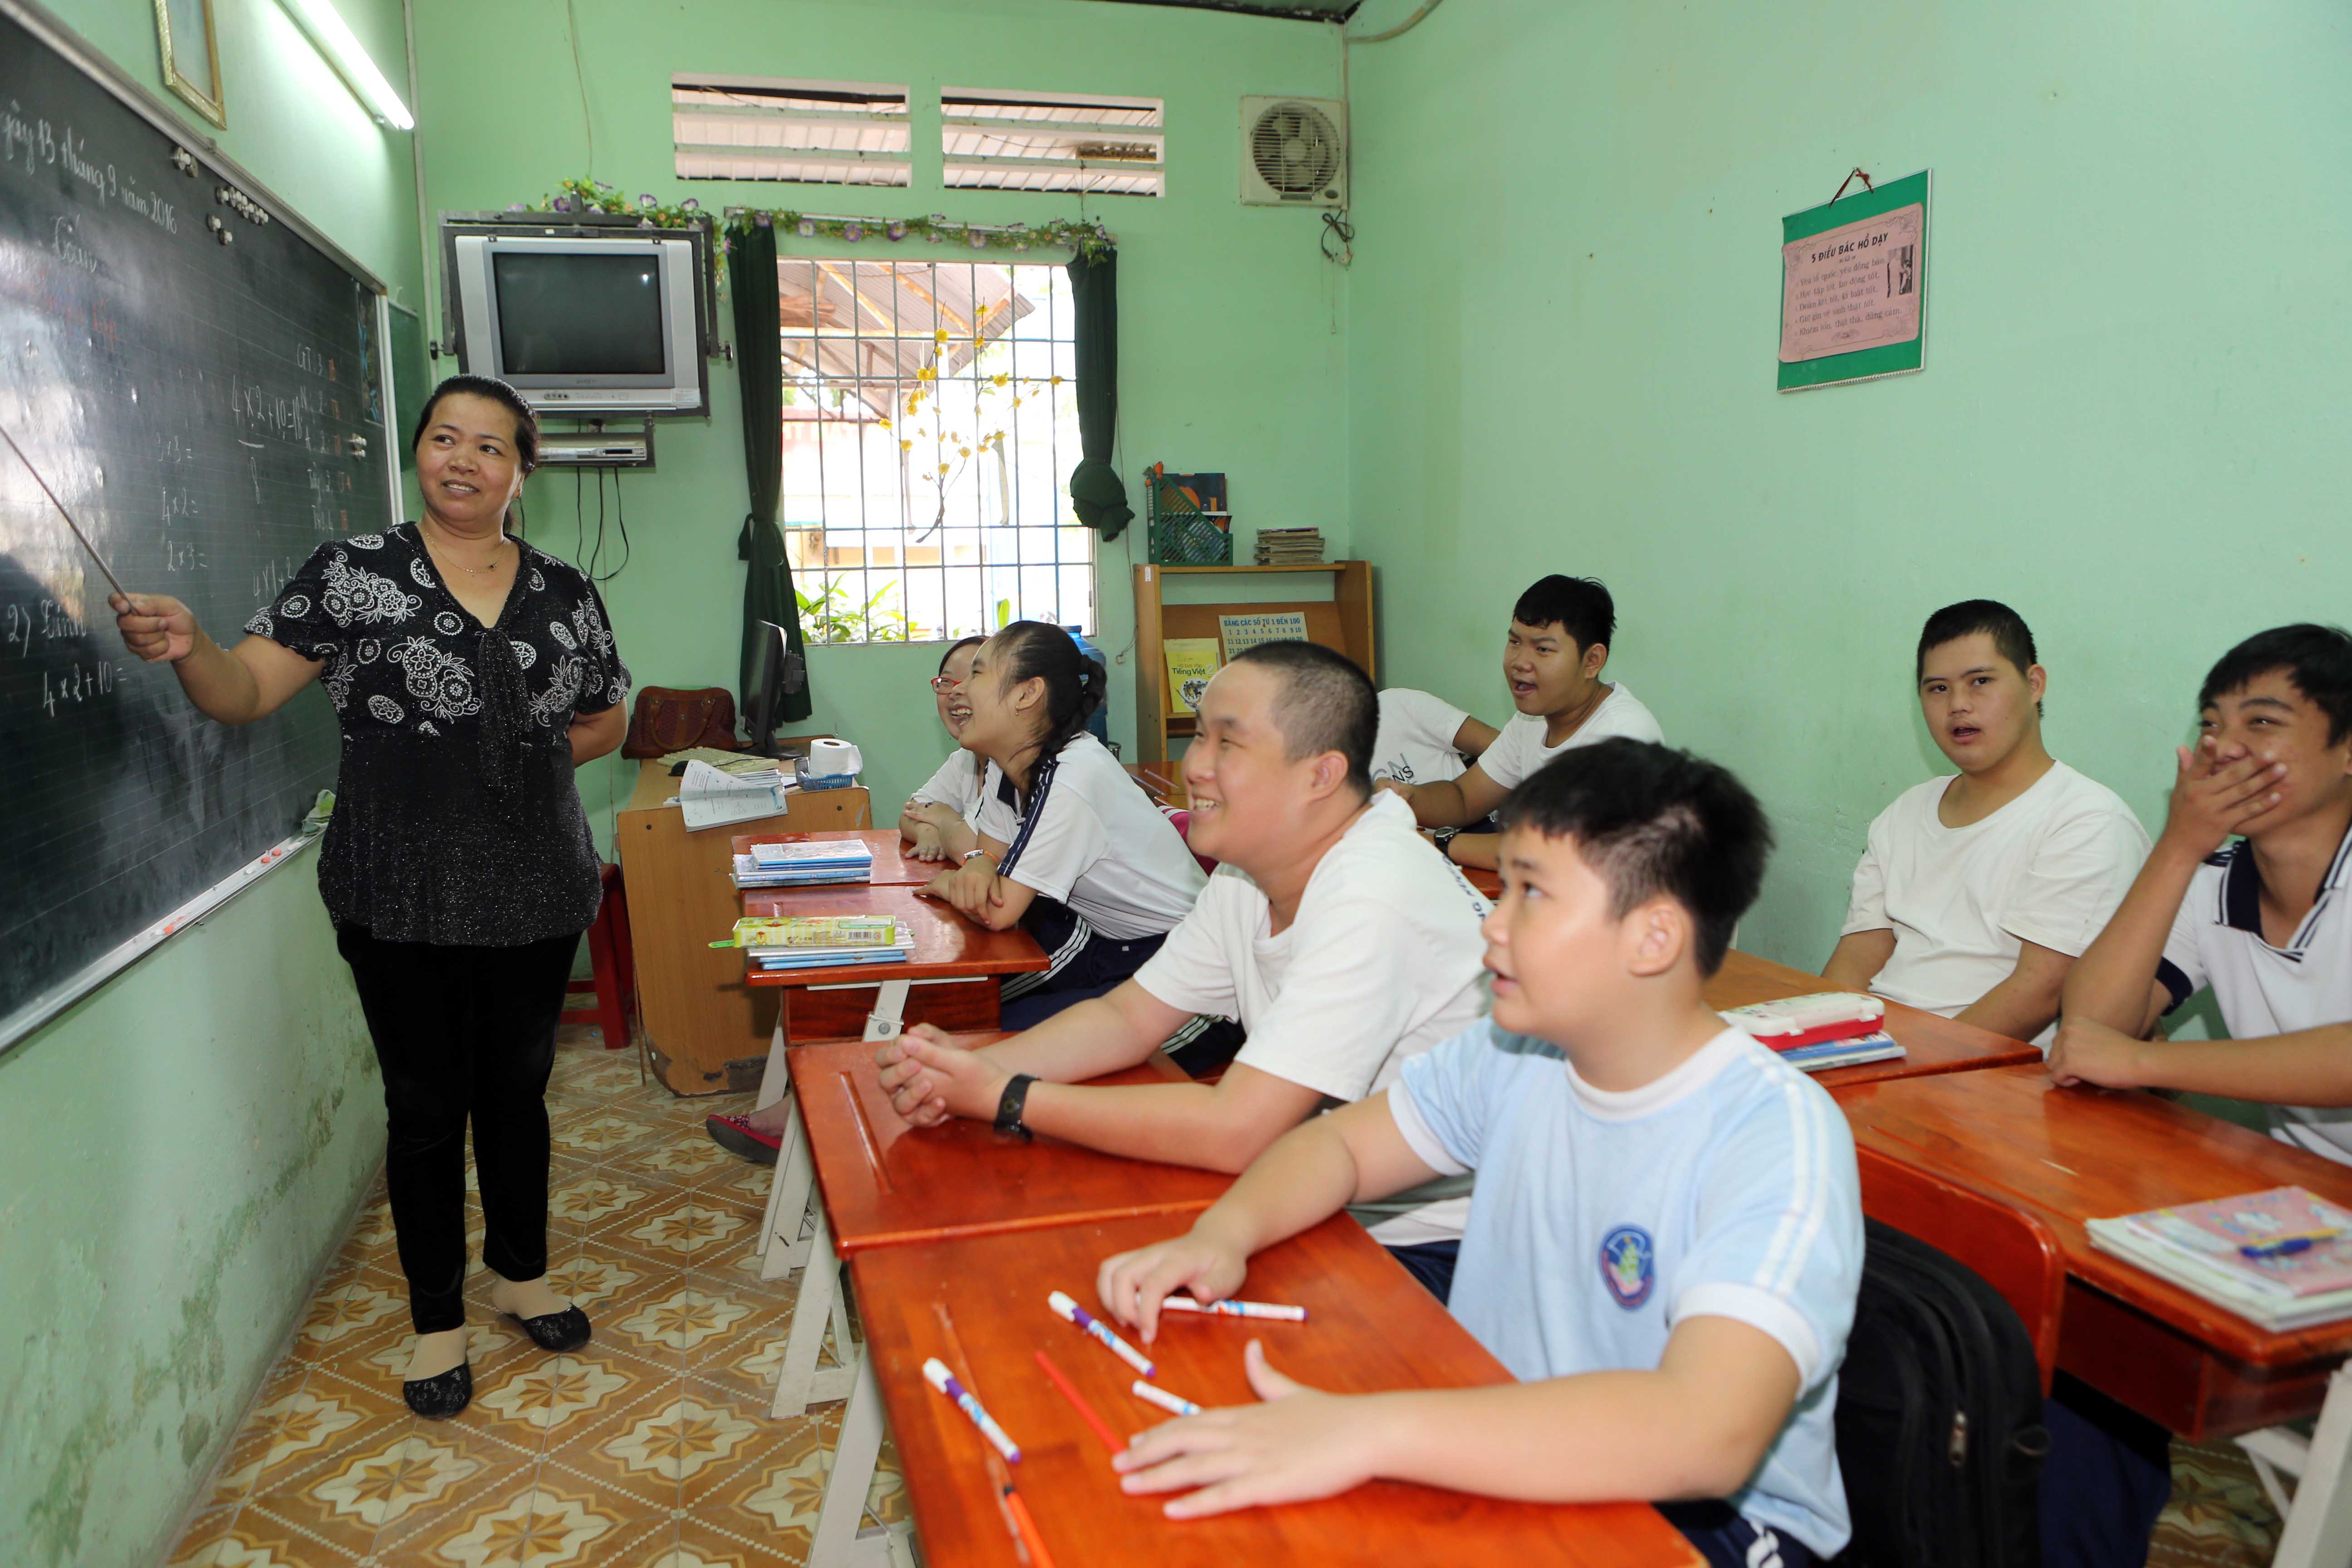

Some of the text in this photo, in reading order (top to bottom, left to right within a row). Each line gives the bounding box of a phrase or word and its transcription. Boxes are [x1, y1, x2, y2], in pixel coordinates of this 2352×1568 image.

[38, 118, 55, 165] 13
[61, 127, 105, 208] tháng
[108, 164, 116, 196] 9
[121, 175, 149, 216] năm
[151, 191, 177, 234] 2016
[1812, 253, 1816, 263] 5
[1839, 240, 1855, 255] BÁC
[1872, 232, 1888, 247] DẠY
[8, 603, 30, 658] 2)
[1224, 618, 1239, 626] BẢNG
[1253, 617, 1260, 625] SỐ
[1277, 616, 1288, 624] ĐẾN
[1172, 667, 1191, 676] Tiếng
[1206, 664, 1215, 676] 2
